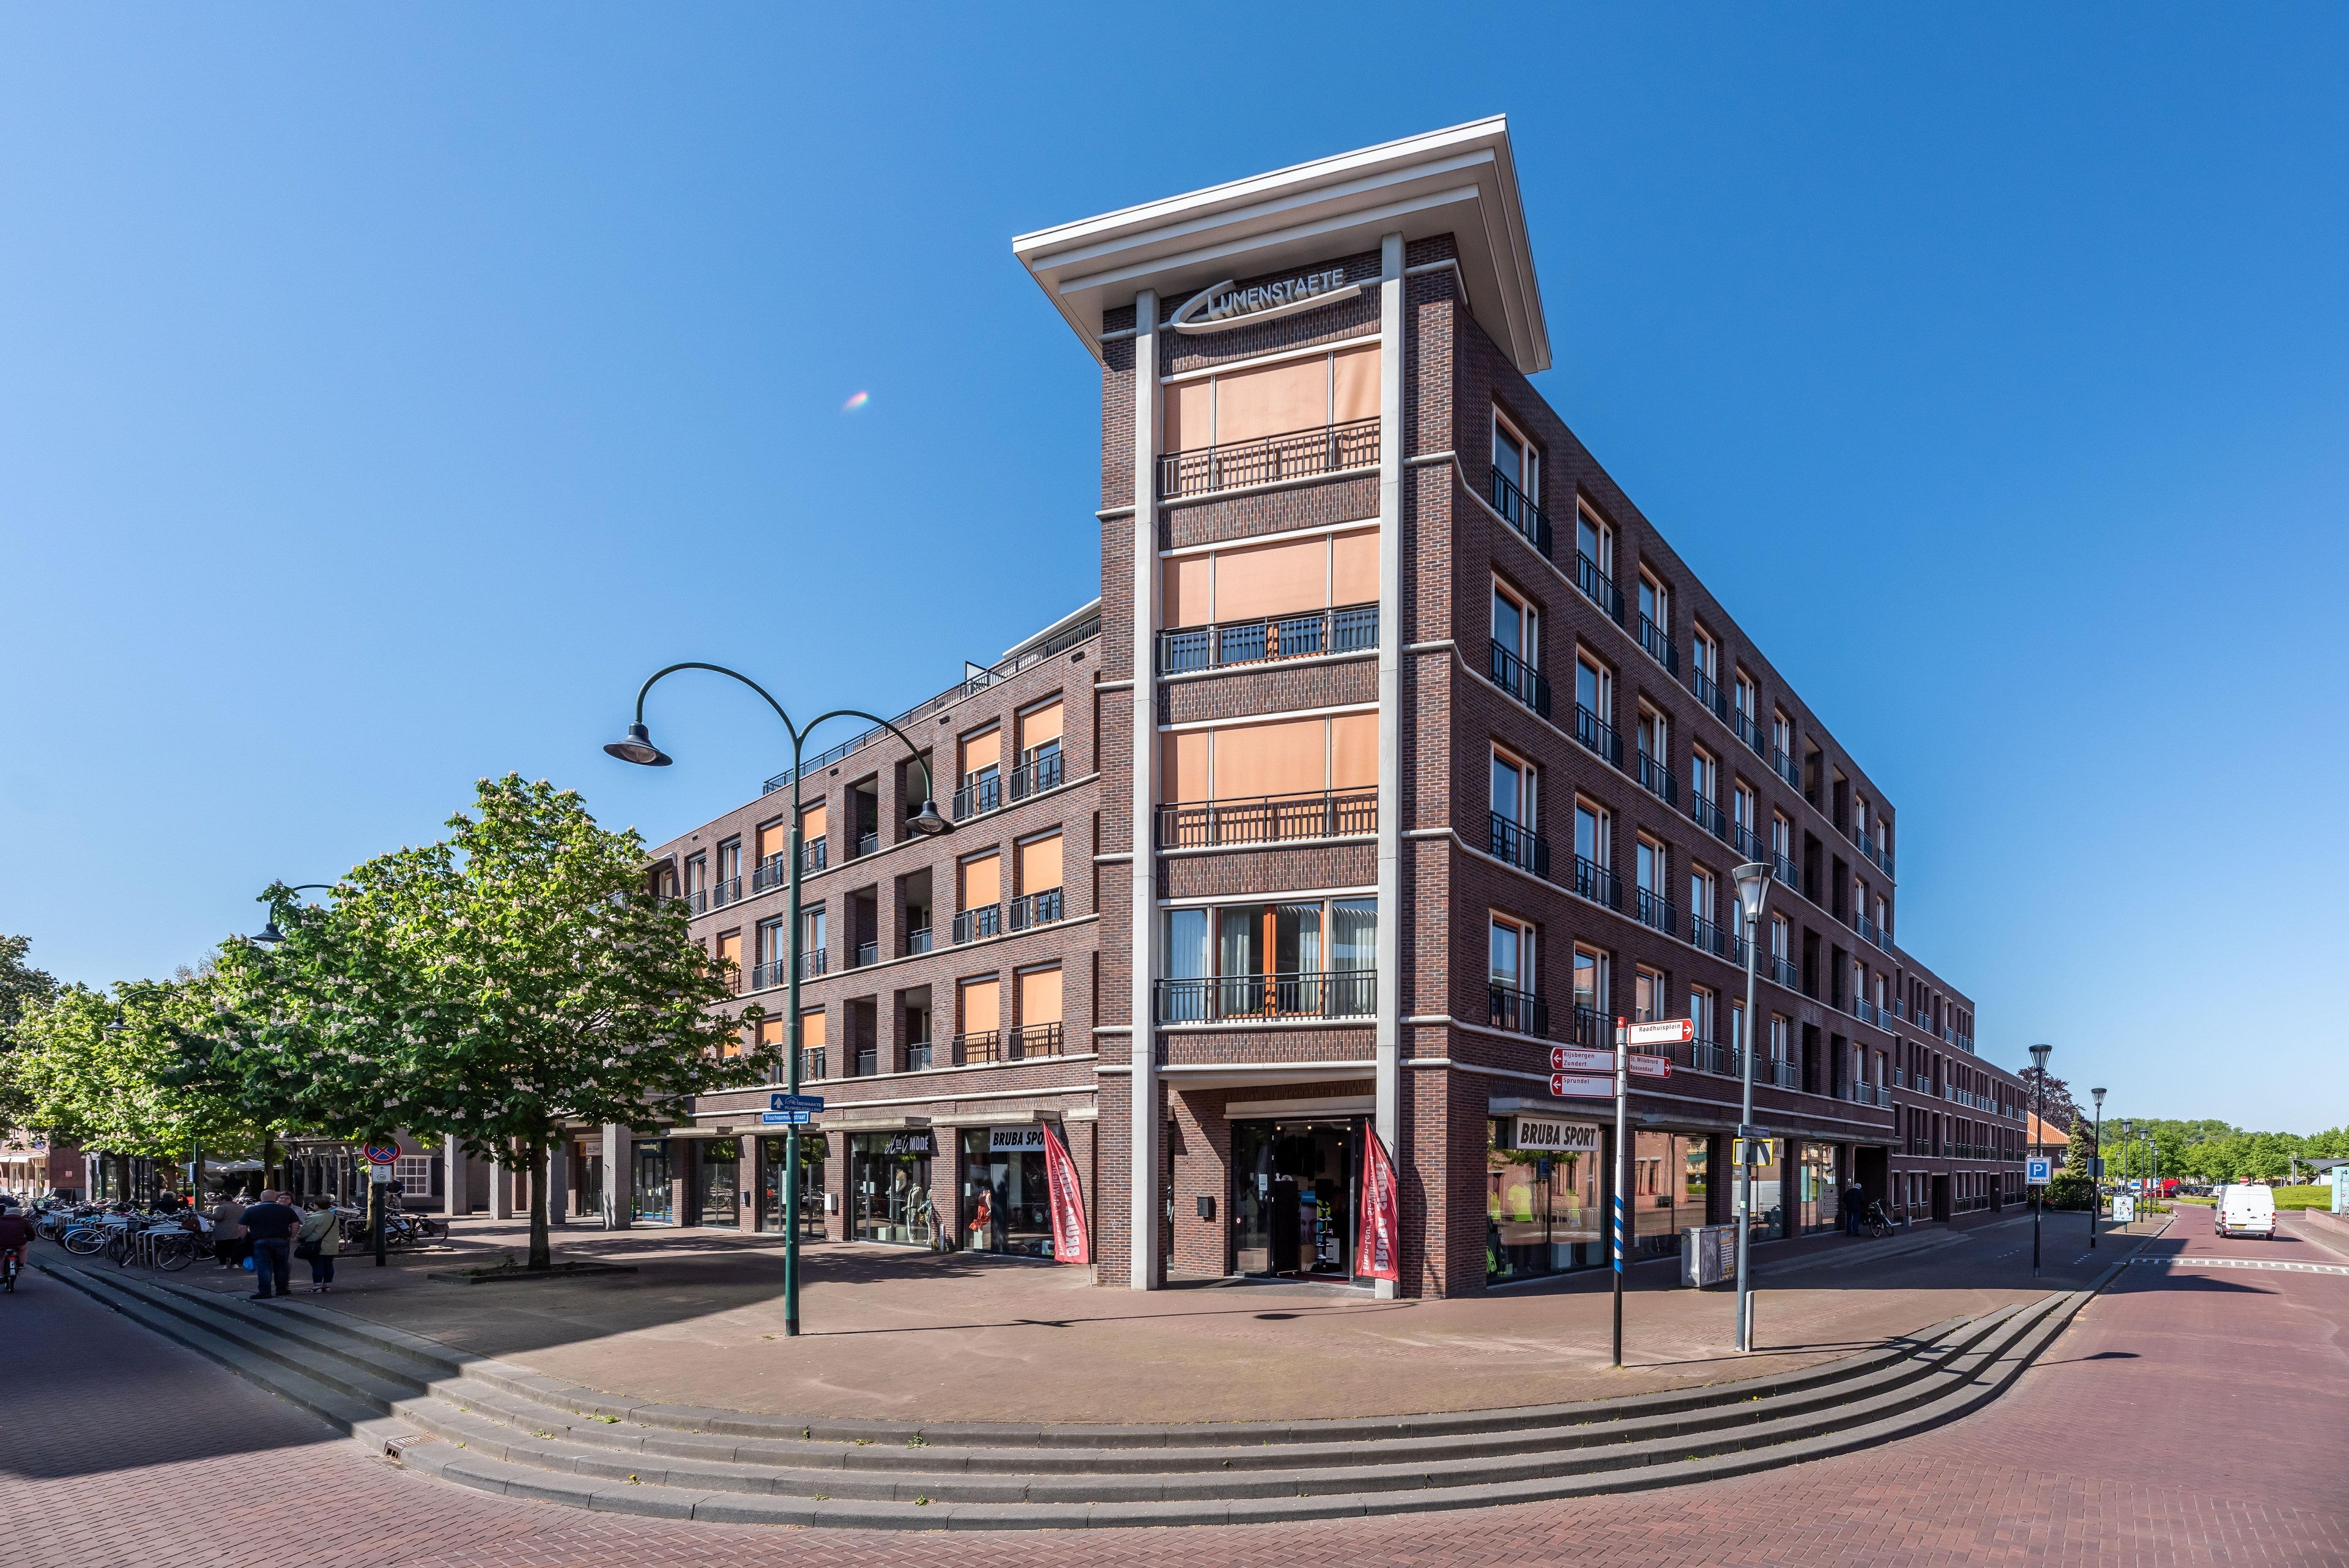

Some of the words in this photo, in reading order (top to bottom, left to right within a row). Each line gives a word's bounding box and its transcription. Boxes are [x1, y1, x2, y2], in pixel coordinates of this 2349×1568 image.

[1639, 1023, 1681, 1033] Raadhuisplein
[993, 1131, 1023, 1146] BRUBA
[1026, 1131, 1045, 1146] SPO
[1520, 1123, 1560, 1145] BRUBA
[1564, 1126, 1597, 1146] SPORT
[909, 1135, 929, 1151] MODE
[2033, 1164, 2043, 1176] P
